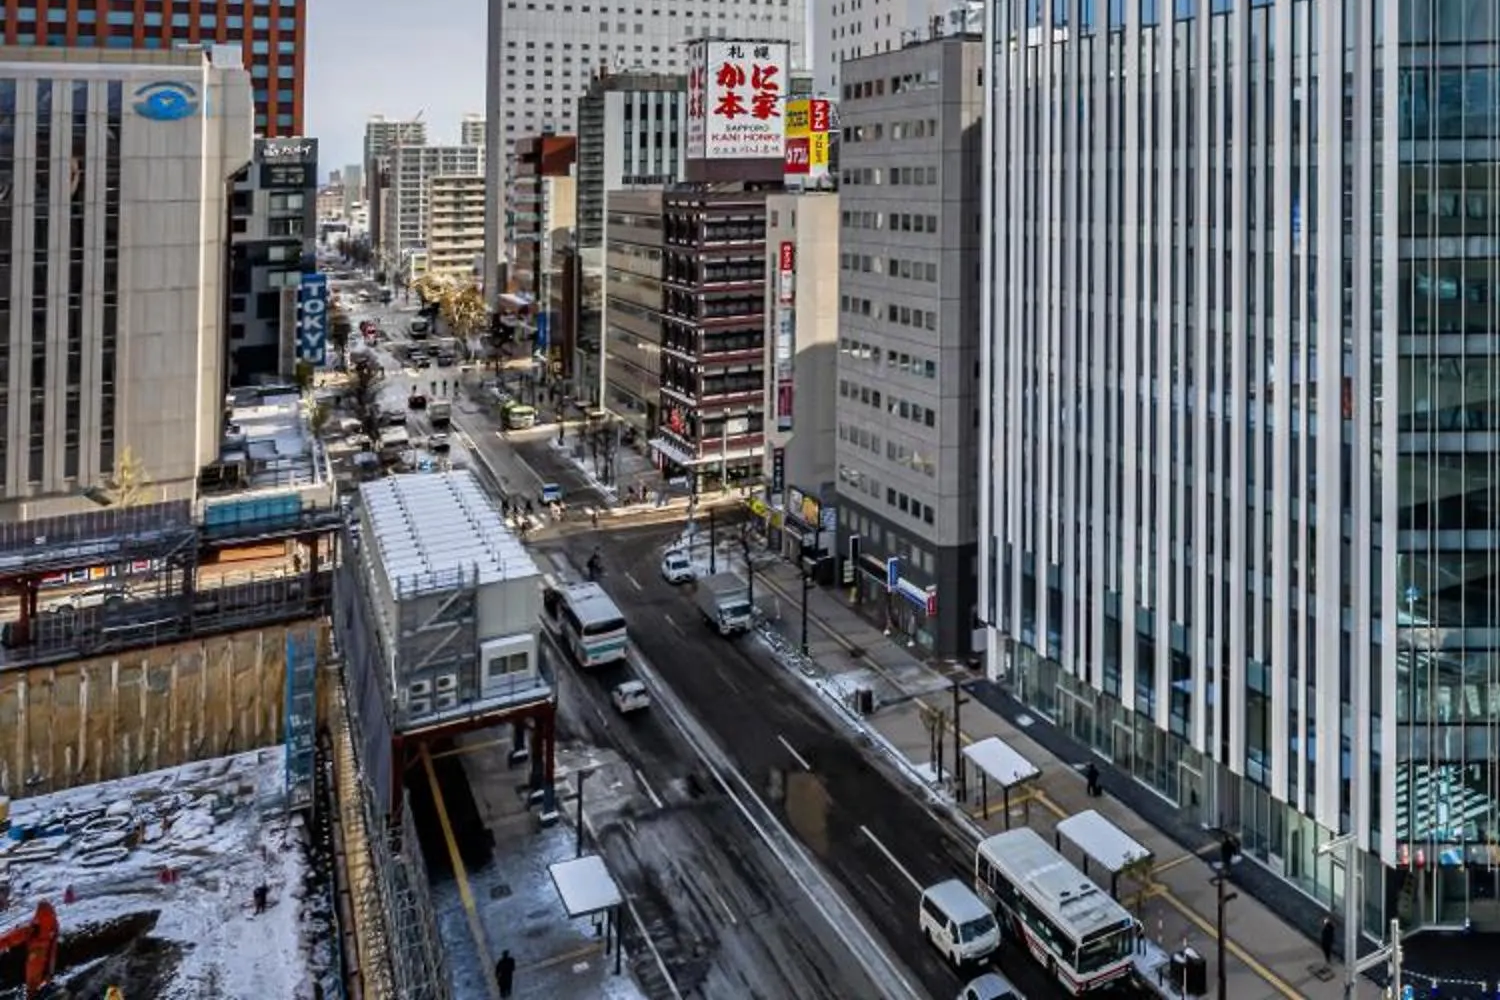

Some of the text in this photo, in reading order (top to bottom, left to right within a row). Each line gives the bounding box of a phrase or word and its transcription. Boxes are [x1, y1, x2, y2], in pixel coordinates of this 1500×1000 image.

[729, 45, 769, 60] 札幌
[716, 62, 779, 90] かに
[714, 92, 780, 120] 本家
[814, 102, 825, 130] アコム
[711, 133, 739, 141] KANI
[303, 282, 325, 362] TOKYU
